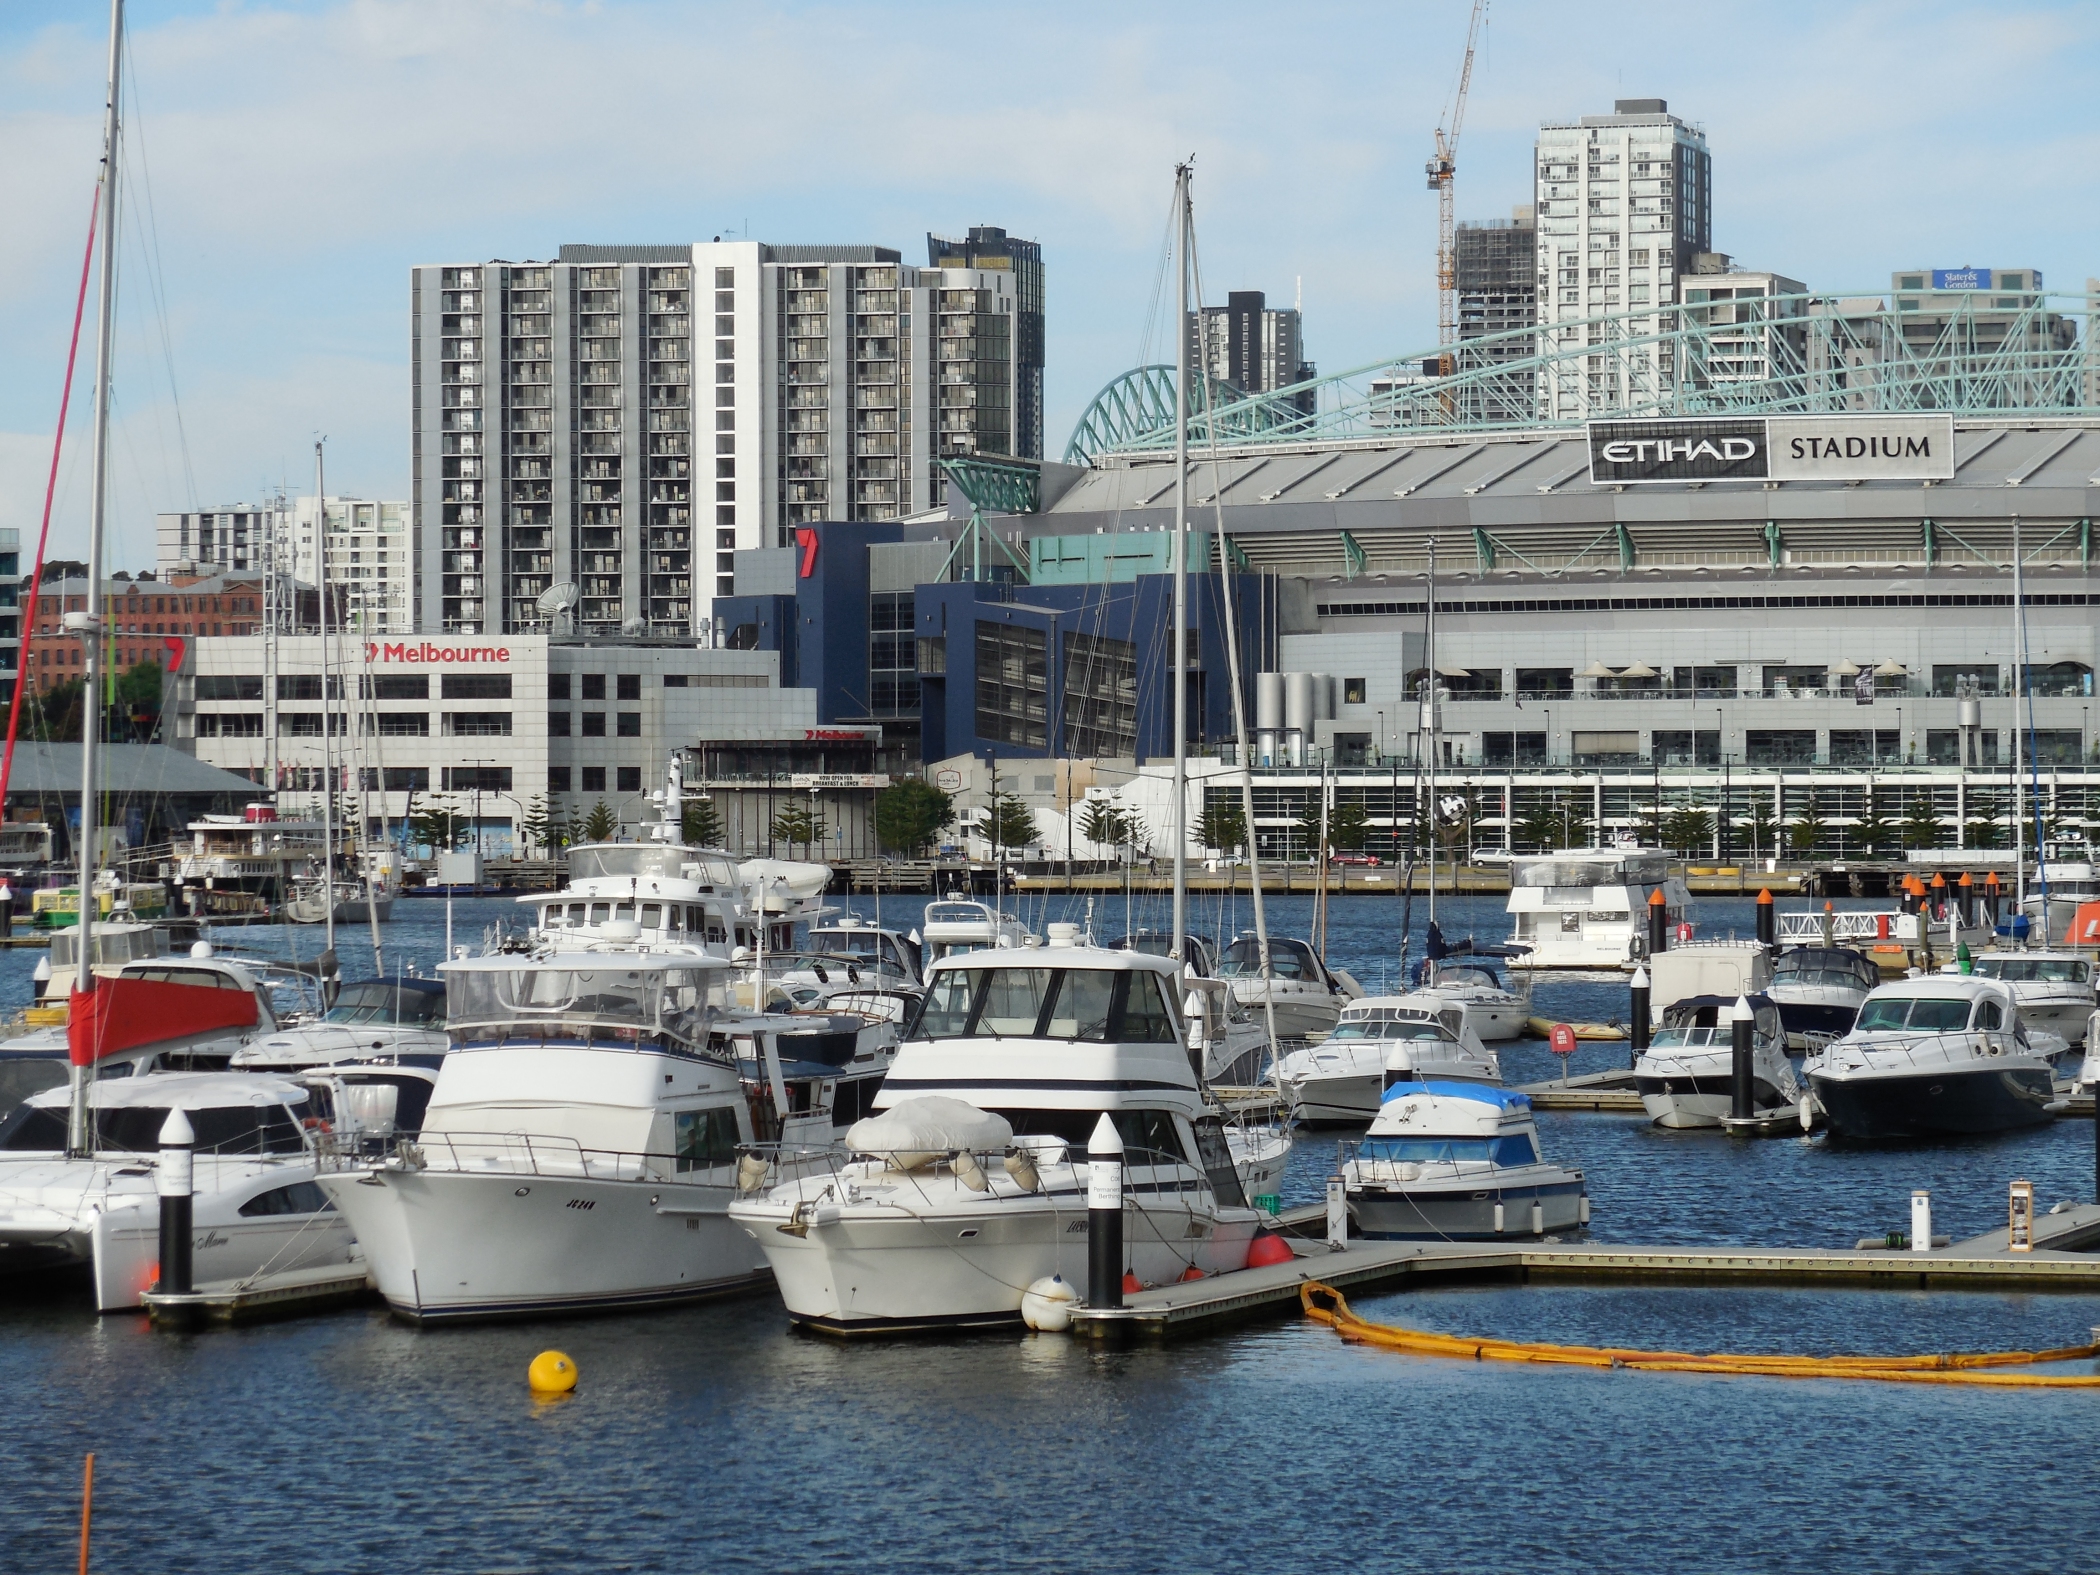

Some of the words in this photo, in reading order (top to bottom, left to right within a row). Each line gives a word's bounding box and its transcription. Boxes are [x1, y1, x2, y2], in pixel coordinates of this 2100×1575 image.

[1945, 281, 1977, 289] Gordon
[1602, 437, 1756, 464] ETIHAD
[1791, 436, 1931, 460] STADIUM
[383, 642, 510, 663] Melbourne
[1098, 1193, 1121, 1201] Berthing
